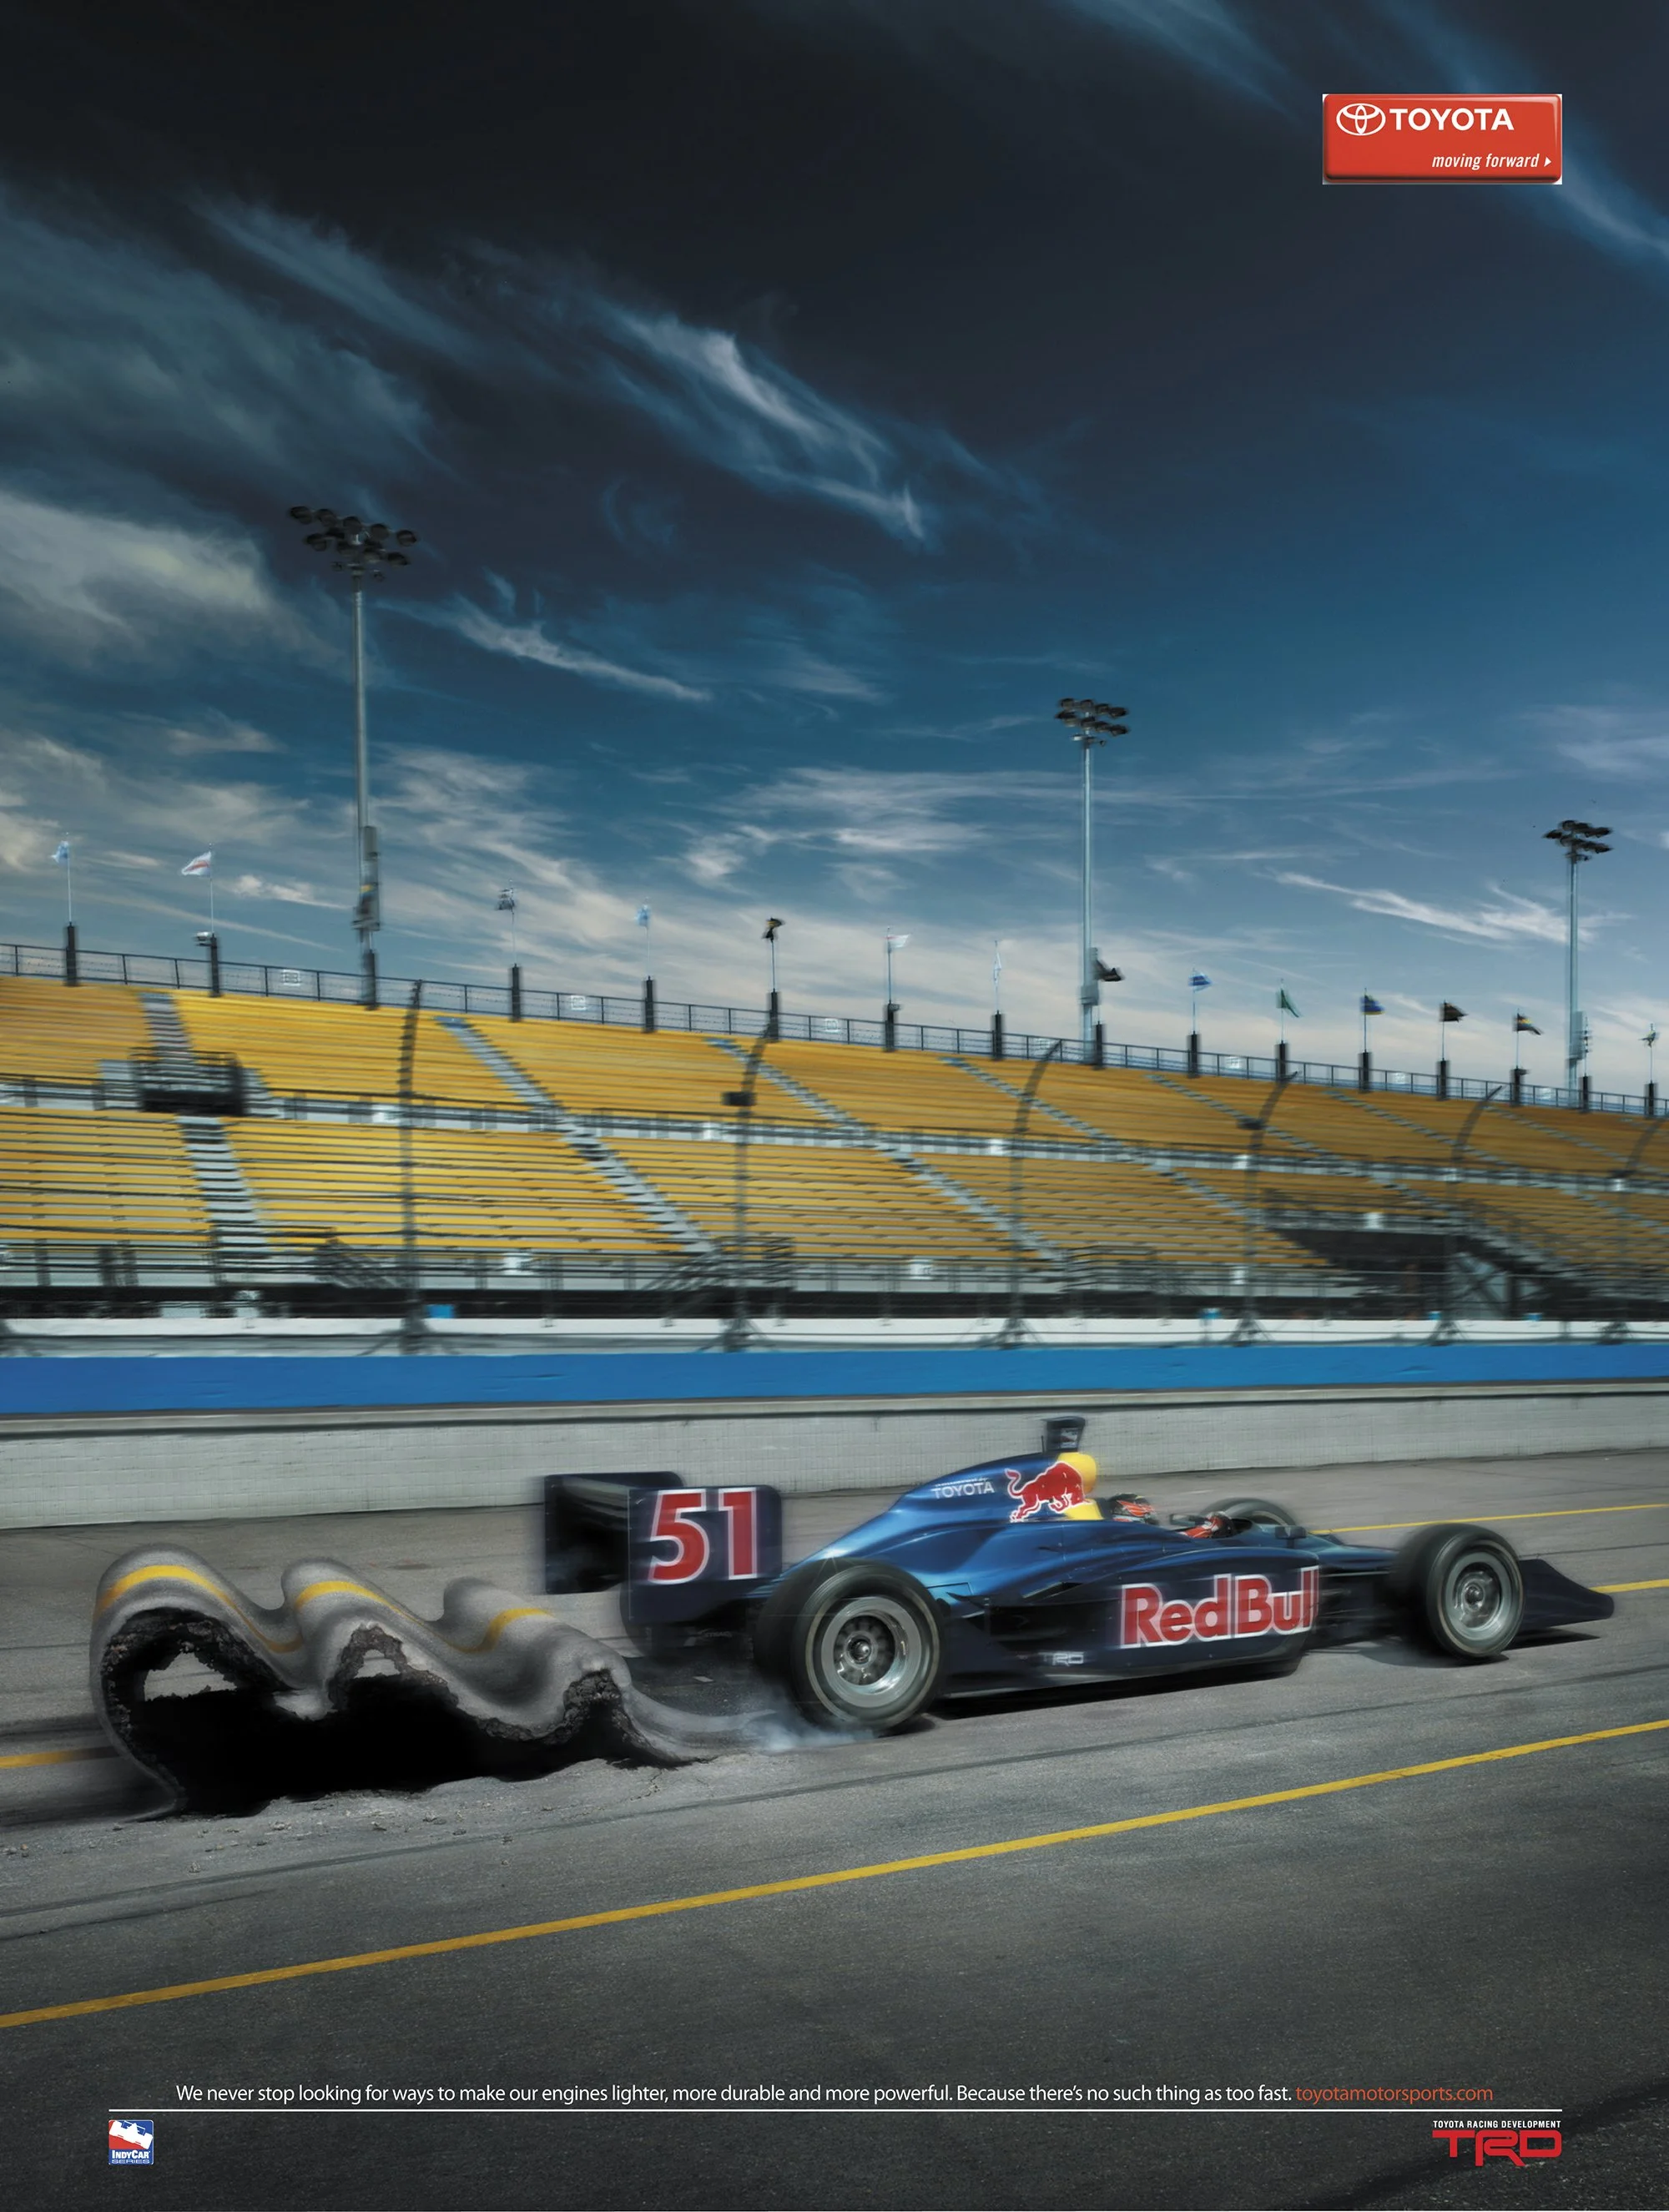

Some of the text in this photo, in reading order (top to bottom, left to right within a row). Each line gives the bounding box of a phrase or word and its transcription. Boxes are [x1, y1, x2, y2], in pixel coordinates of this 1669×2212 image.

[930, 1481, 995, 1499] TOYOTA
[648, 1487, 758, 1585] 51
[1120, 1573, 1232, 1649] Red
